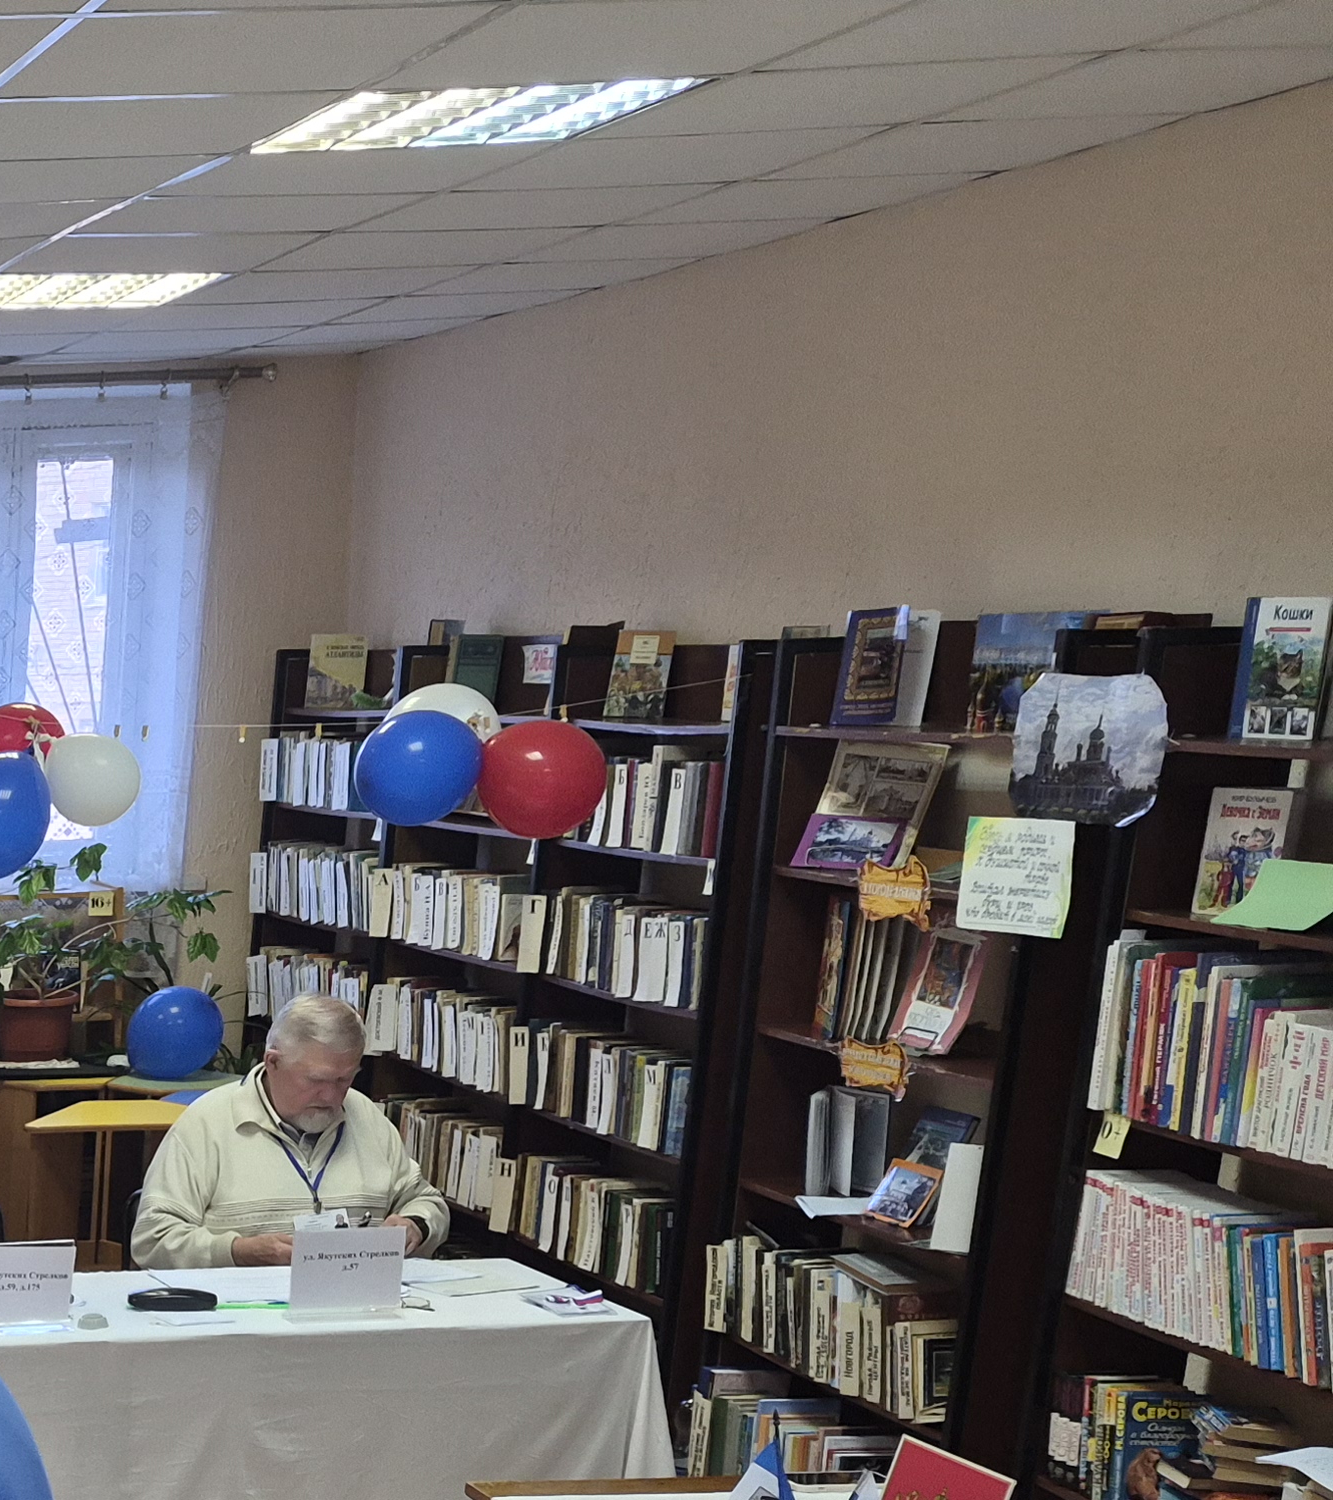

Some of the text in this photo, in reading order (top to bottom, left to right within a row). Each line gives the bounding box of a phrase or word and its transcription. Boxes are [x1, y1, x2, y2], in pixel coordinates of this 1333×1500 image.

[1274, 605, 1314, 621] Кошки
[674, 773, 682, 790] В
[377, 873, 389, 886] А
[414, 877, 422, 892] Б
[90, 896, 112, 909] 16+
[530, 899, 542, 914] Г
[624, 919, 633, 936] Д
[514, 1032, 525, 1047] И
[1314, 1036, 1331, 1100] ДЕТСКИЙ МИР
[646, 1069, 656, 1085] М
[1295, 1074, 1311, 1134] ВРЕМЕНА ГОДА
[500, 1162, 511, 1177] Н
[302, 1250, 400, 1262] ул. Якутских Стрелков
[341, 1263, 359, 1272] д.57
[29, 1271, 69, 1280] Стрелков
[0, 1283, 19, 1292] д.59,
[1116, 1395, 1127, 1437] СЕРОВА
[1132, 1401, 1191, 1422] СЕРОВ
